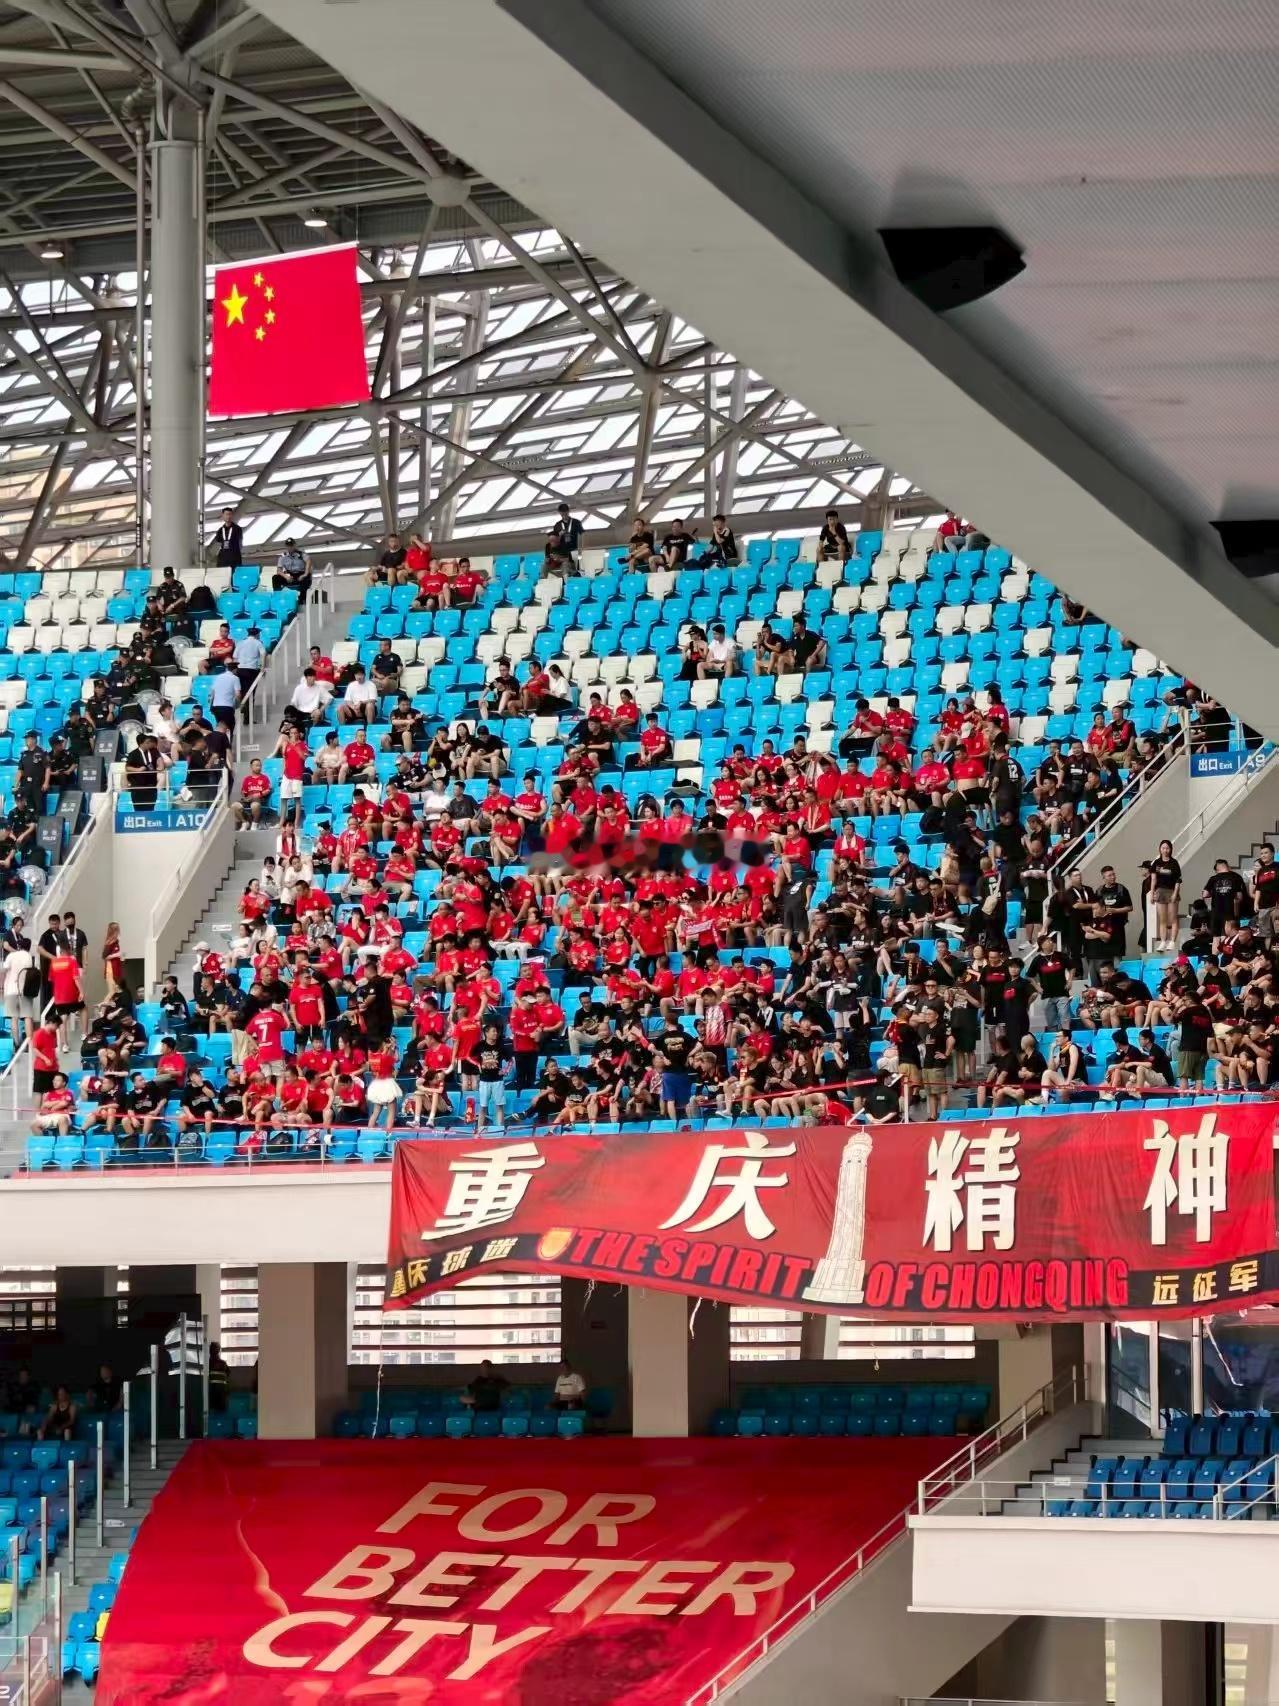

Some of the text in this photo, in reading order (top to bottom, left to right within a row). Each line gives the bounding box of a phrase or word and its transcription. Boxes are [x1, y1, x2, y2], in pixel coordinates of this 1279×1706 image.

[1198, 758, 1218, 771] 出口
[1219, 762, 1233, 770] Exit
[123, 814, 207, 829] 出口 Exit A10
[570, 1230, 1130, 1313] THE SPIRIT OF CHONGQING
[1151, 1259, 1259, 1306] 远征军
[374, 1481, 657, 1547] FOR
[301, 1544, 796, 1616] BETTER
[242, 1610, 553, 1682] CITY
